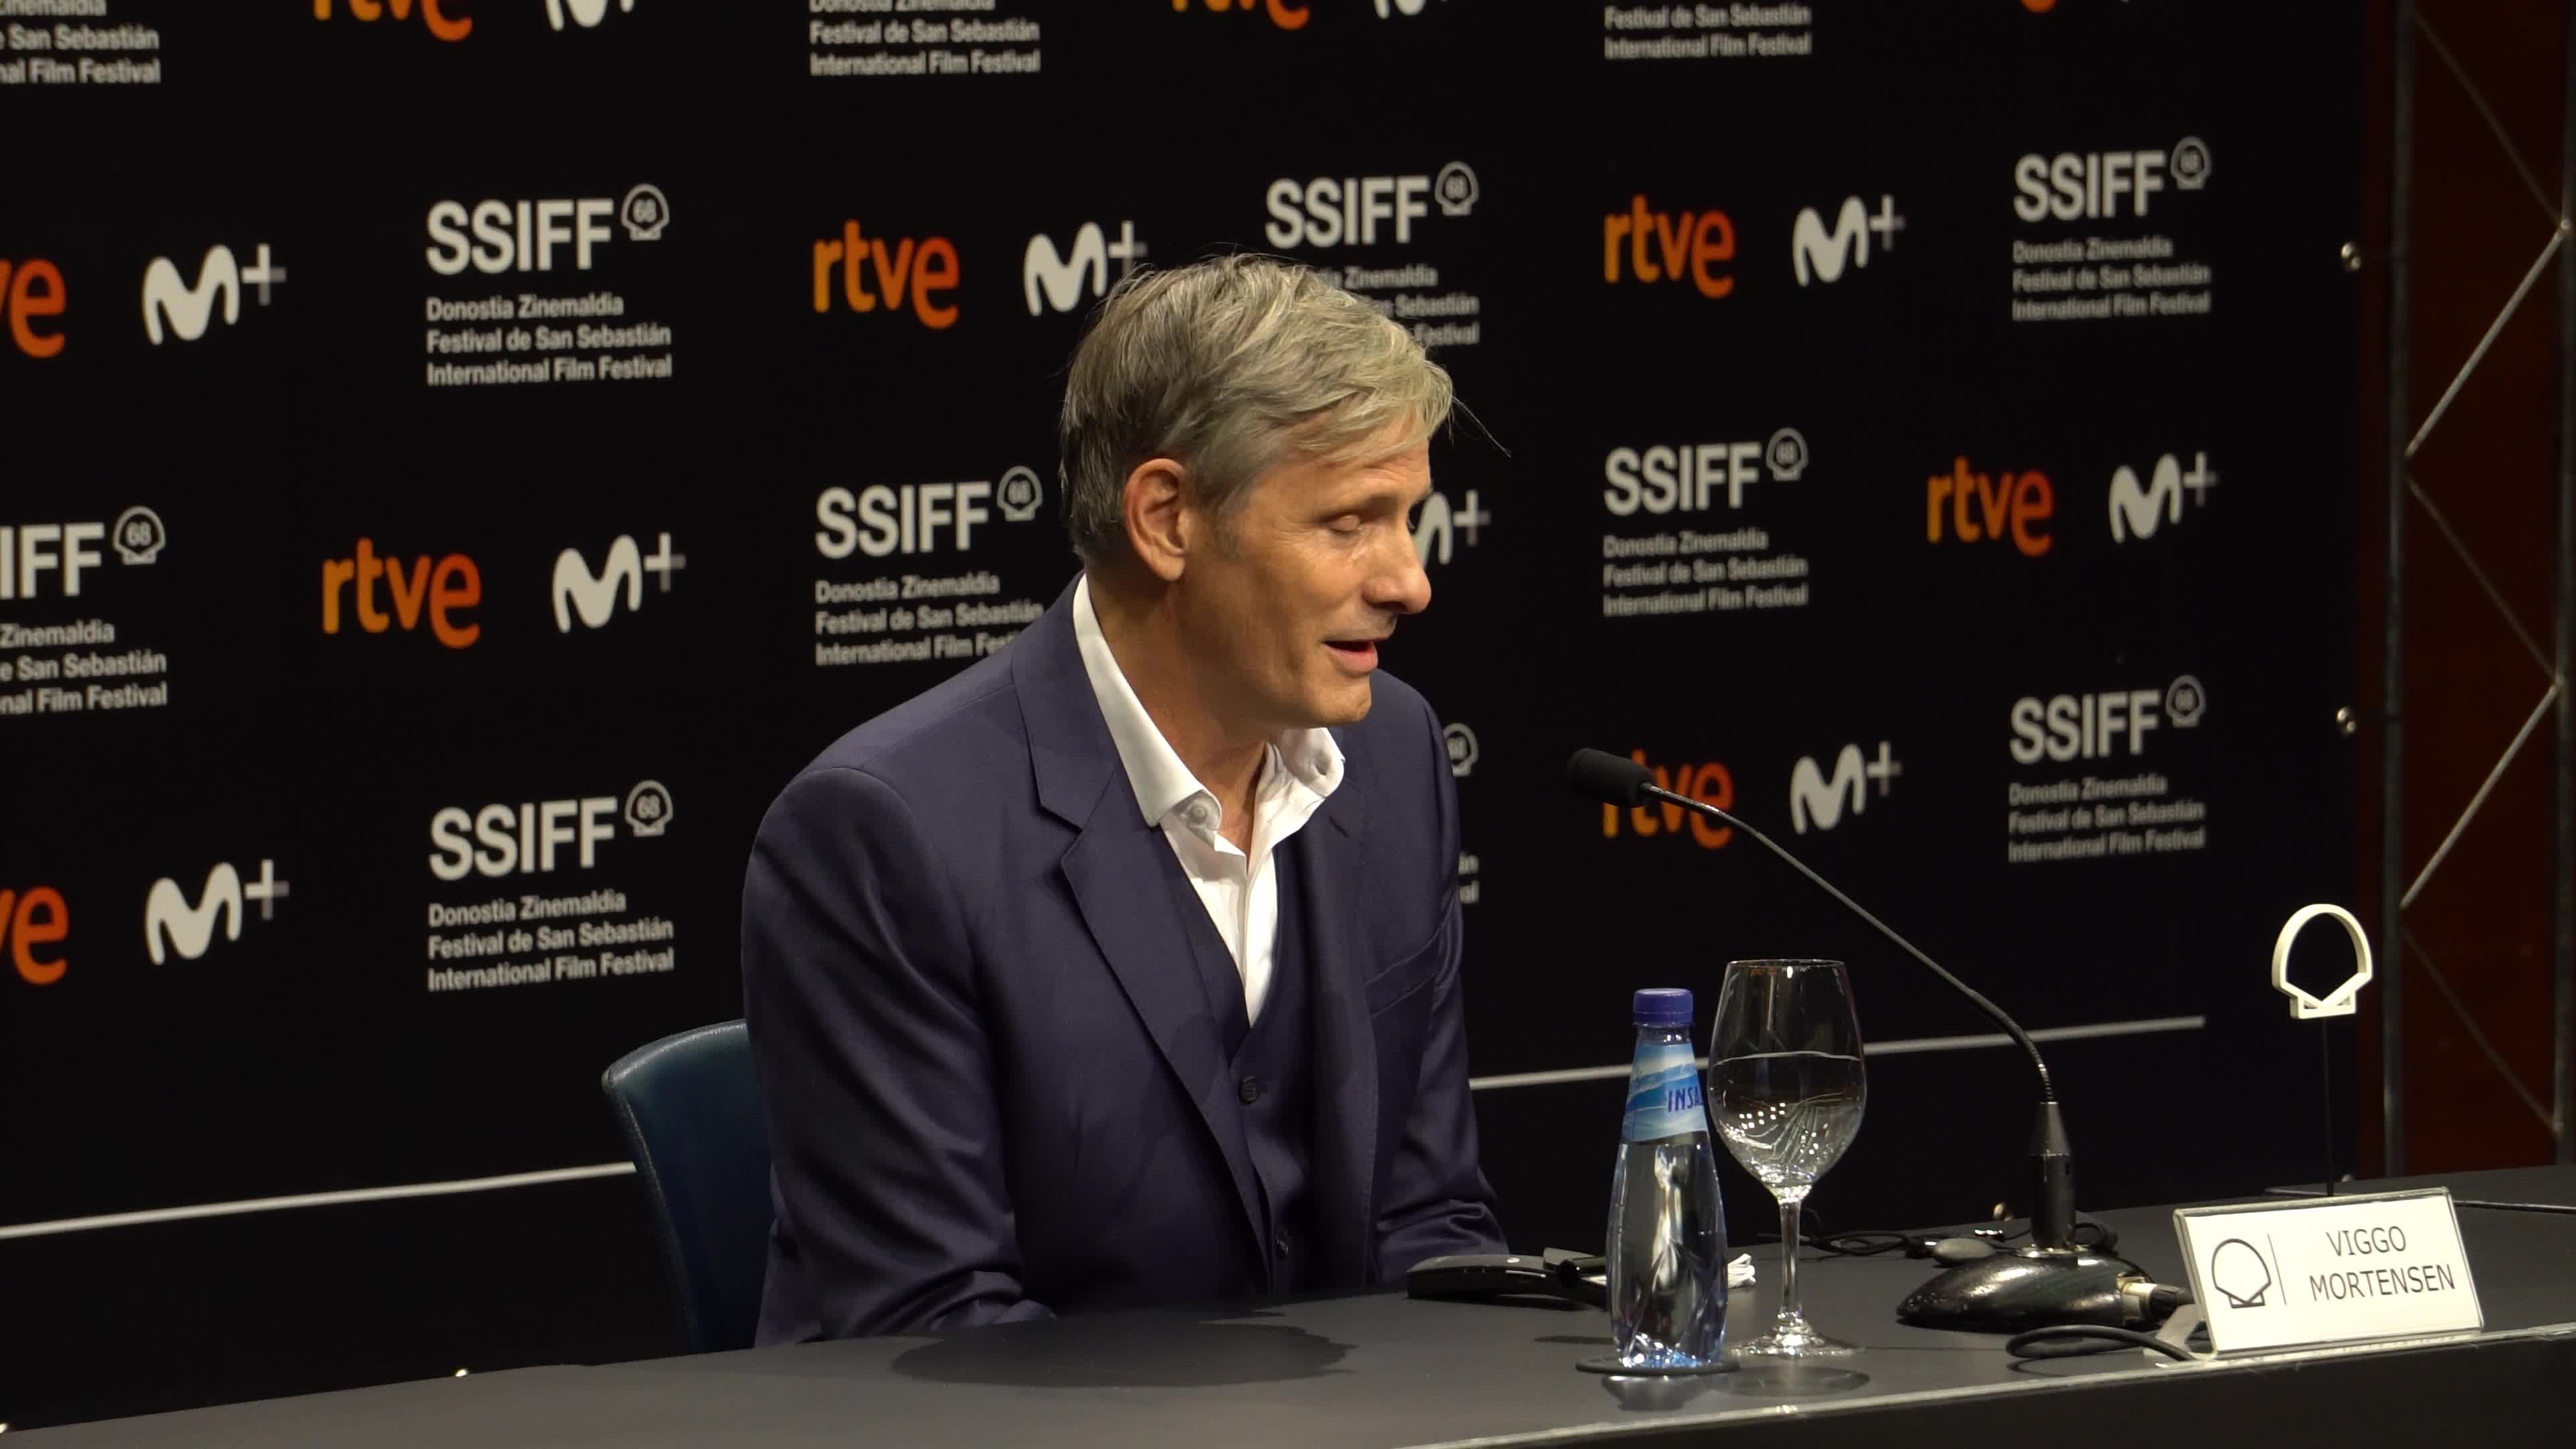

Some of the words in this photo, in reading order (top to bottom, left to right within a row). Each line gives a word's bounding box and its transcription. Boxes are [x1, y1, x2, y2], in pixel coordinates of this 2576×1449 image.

[809, 20, 882, 44] Festival
[883, 20, 910, 44] de
[911, 19, 949, 44] San
[950, 17, 1040, 43] Sebastián
[1604, 6, 1670, 30] Festival
[1670, 7, 1694, 28] de
[1695, 4, 1729, 28] San
[8, 23, 52, 50] San
[54, 23, 160, 50] Sebastián
[1604, 36, 1709, 59] International
[1710, 34, 1746, 56] Film
[1748, 32, 1811, 56] Festival
[29, 58, 76, 83] Film
[78, 58, 161, 83] Festival
[810, 51, 926, 76] International
[928, 50, 969, 74] Film
[970, 49, 1040, 73] Festival
[2014, 150, 2166, 222] SSIFF
[1265, 175, 1430, 249] SSIFF
[425, 198, 614, 275] SSIFF
[1603, 194, 1736, 298] rtve
[2013, 241, 2084, 264] Donostia
[2086, 237, 2172, 260] Zinemaldia
[813, 219, 960, 329] rtve
[1344, 264, 1438, 290] Zinemaldia
[2012, 270, 2074, 292] Festival
[2076, 268, 2097, 289] de
[2100, 266, 2131, 288] San
[426, 295, 515, 321] Donostia
[518, 292, 624, 319] Zinemaldia
[2012, 297, 2111, 320] International
[2113, 294, 2148, 315] Film
[2149, 292, 2210, 313] Festival
[426, 328, 502, 354] Festival
[505, 327, 532, 351] de
[535, 325, 574, 351] San
[576, 321, 672, 349] Sebastián
[427, 358, 550, 386] International
[553, 357, 595, 381] Film
[598, 354, 672, 380] Festival
[1604, 442, 1762, 516] SSIFF
[815, 481, 991, 559] SSIFF
[1927, 456, 2054, 556] rtve
[1603, 535, 1678, 557] Donostia
[1679, 528, 1768, 553] Zinemaldia
[0, 522, 105, 600] IFF
[1603, 563, 1667, 586] Festival
[1668, 561, 1691, 583] de
[1693, 559, 1726, 582] San
[322, 537, 482, 649] rtve
[815, 579, 899, 604] Donostia
[901, 571, 1000, 599] Zinemaldia
[1603, 591, 1706, 616] International
[1708, 588, 1743, 608] Film
[1746, 584, 1808, 607] Festival
[0, 619, 115, 649] Zinemaldia
[815, 608, 887, 635] Festival
[890, 606, 915, 631] de
[917, 604, 953, 629] San
[17, 655, 60, 681] San
[62, 647, 167, 678] Sebastián
[815, 637, 931, 666] International
[933, 634, 973, 659] Film
[36, 687, 83, 712] Film
[87, 681, 168, 710] Festival
[2010, 690, 2161, 763] SSIFF
[429, 796, 618, 881] SSIFF
[429, 898, 517, 928] Donostia
[520, 889, 627, 920] Zinemaldia
[428, 930, 504, 959] Festival
[507, 928, 533, 953] de
[536, 926, 575, 951] San
[578, 916, 674, 947] Sebastián
[427, 958, 551, 991] International
[555, 955, 597, 980] Film
[600, 947, 674, 976] Festival
[2326, 1225, 2407, 1256] VIGGO
[2309, 1263, 2456, 1301] MORTENSEN
